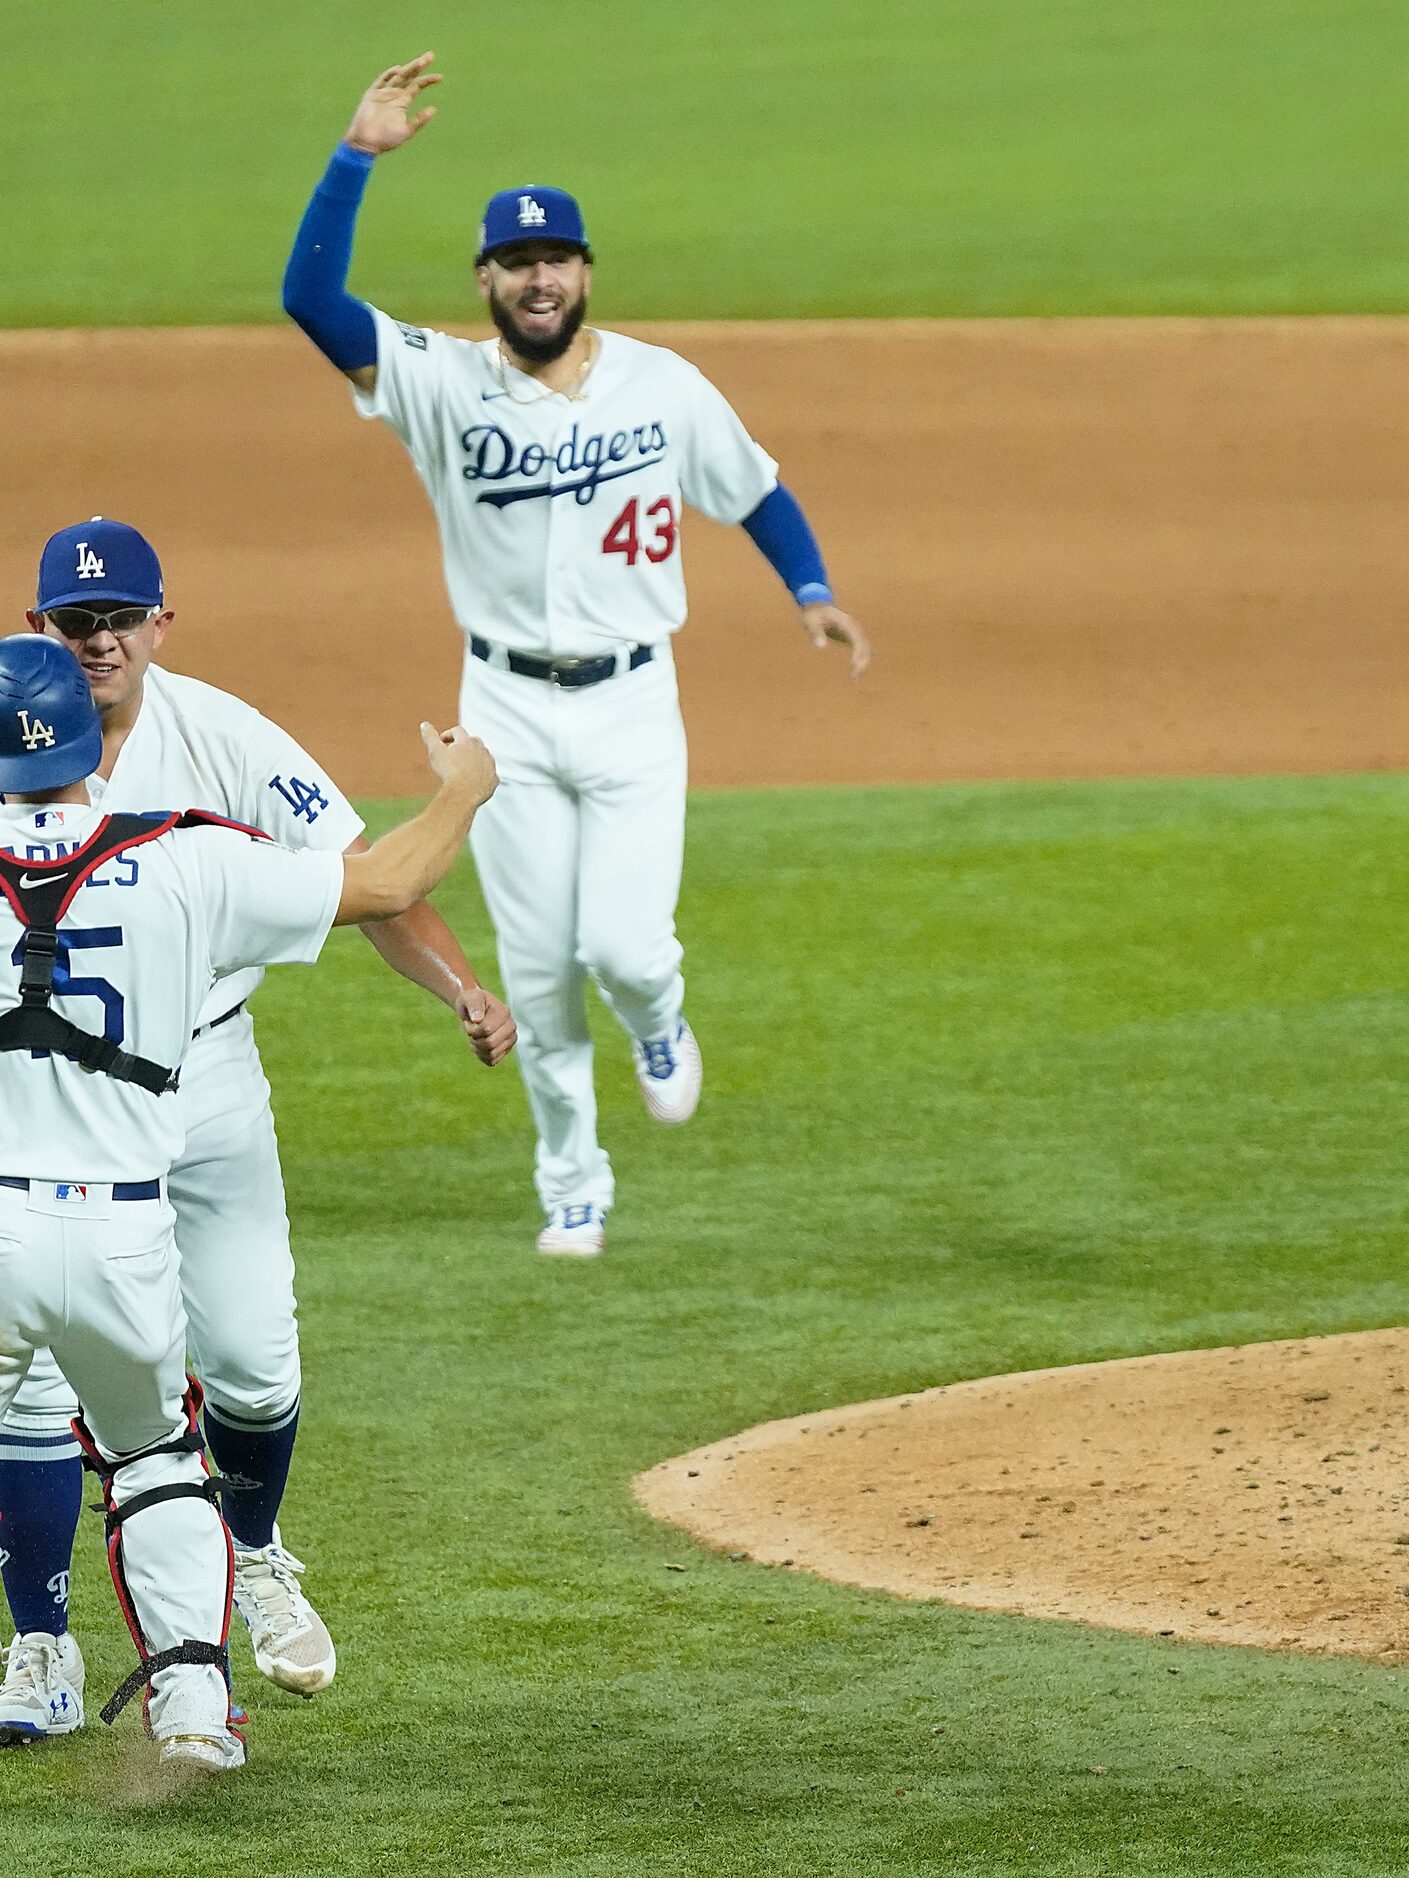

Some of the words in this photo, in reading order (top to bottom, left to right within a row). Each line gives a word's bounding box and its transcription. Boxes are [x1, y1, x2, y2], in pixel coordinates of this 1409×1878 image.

[517, 195, 547, 227] LA
[461, 422, 666, 506] Dodgers
[602, 495, 677, 566] 43
[76, 542, 106, 579] LA
[17, 710, 55, 749] LA
[268, 774, 329, 824] LA
